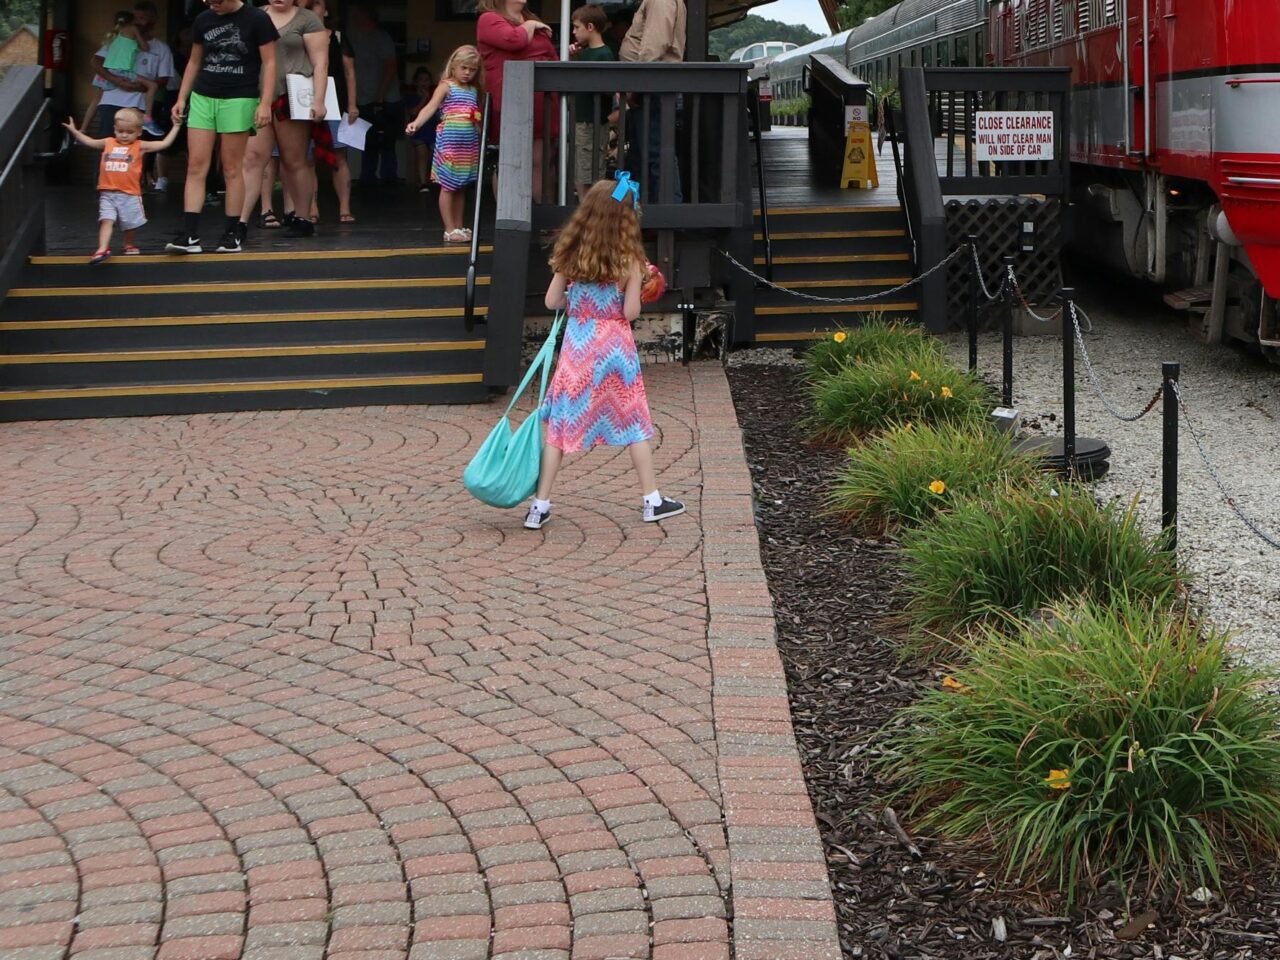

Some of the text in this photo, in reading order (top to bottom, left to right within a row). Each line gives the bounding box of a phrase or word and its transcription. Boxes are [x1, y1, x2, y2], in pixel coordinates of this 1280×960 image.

[978, 117, 1052, 130] CLOSE CLEARANCE
[979, 134, 1052, 144] WILL NOT CLEAR MAN
[988, 145, 1042, 155] ON SIDE OF CAR
